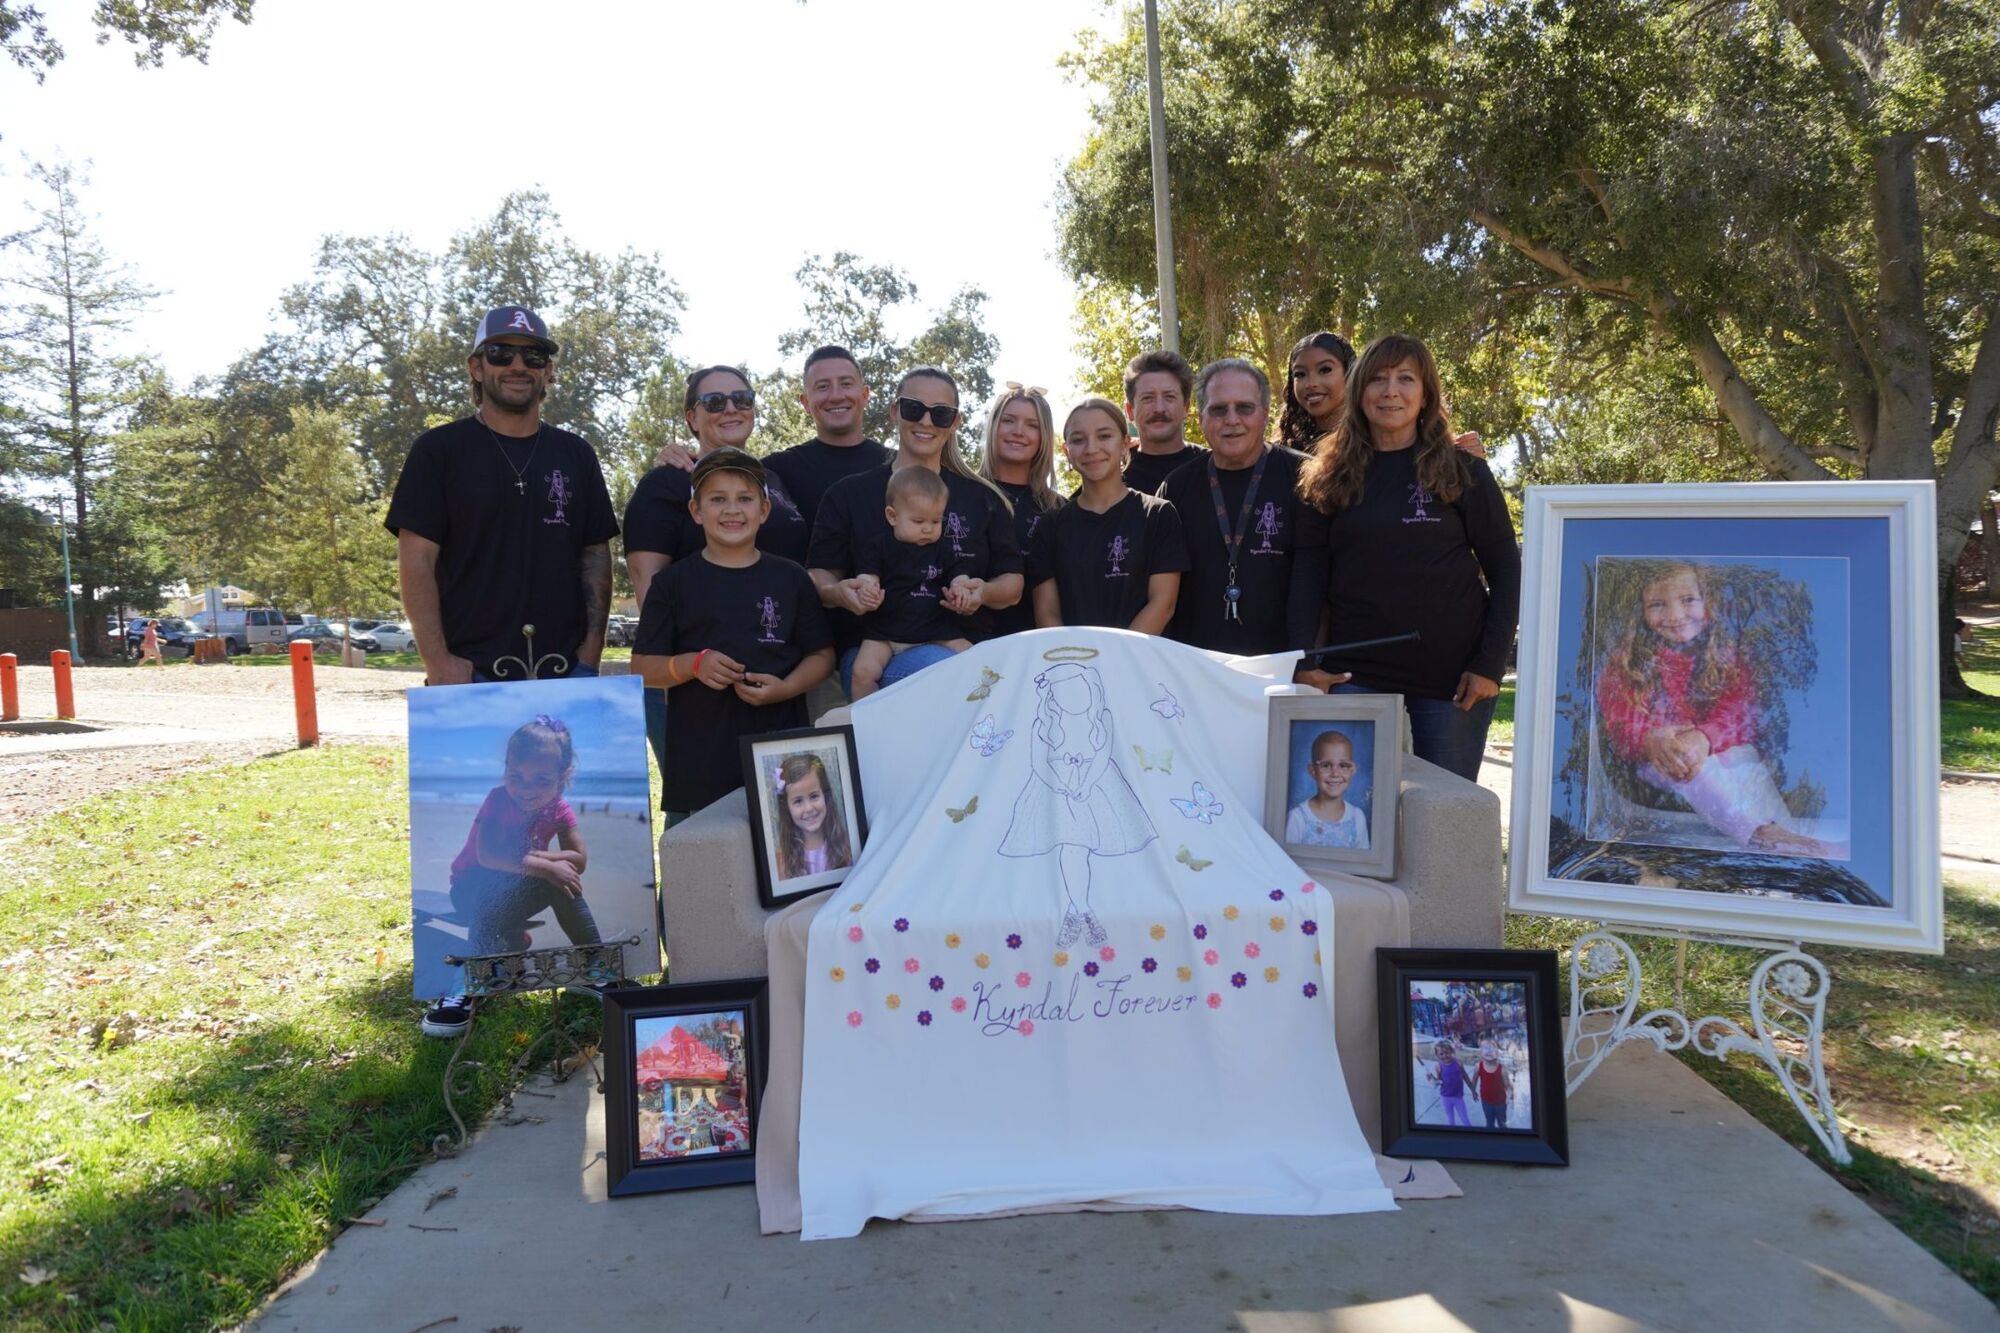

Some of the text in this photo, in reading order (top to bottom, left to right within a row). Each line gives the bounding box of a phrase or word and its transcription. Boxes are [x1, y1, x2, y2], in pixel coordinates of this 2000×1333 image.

[508, 310, 534, 332] A
[973, 971, 1198, 1037] Kyndal Forever
